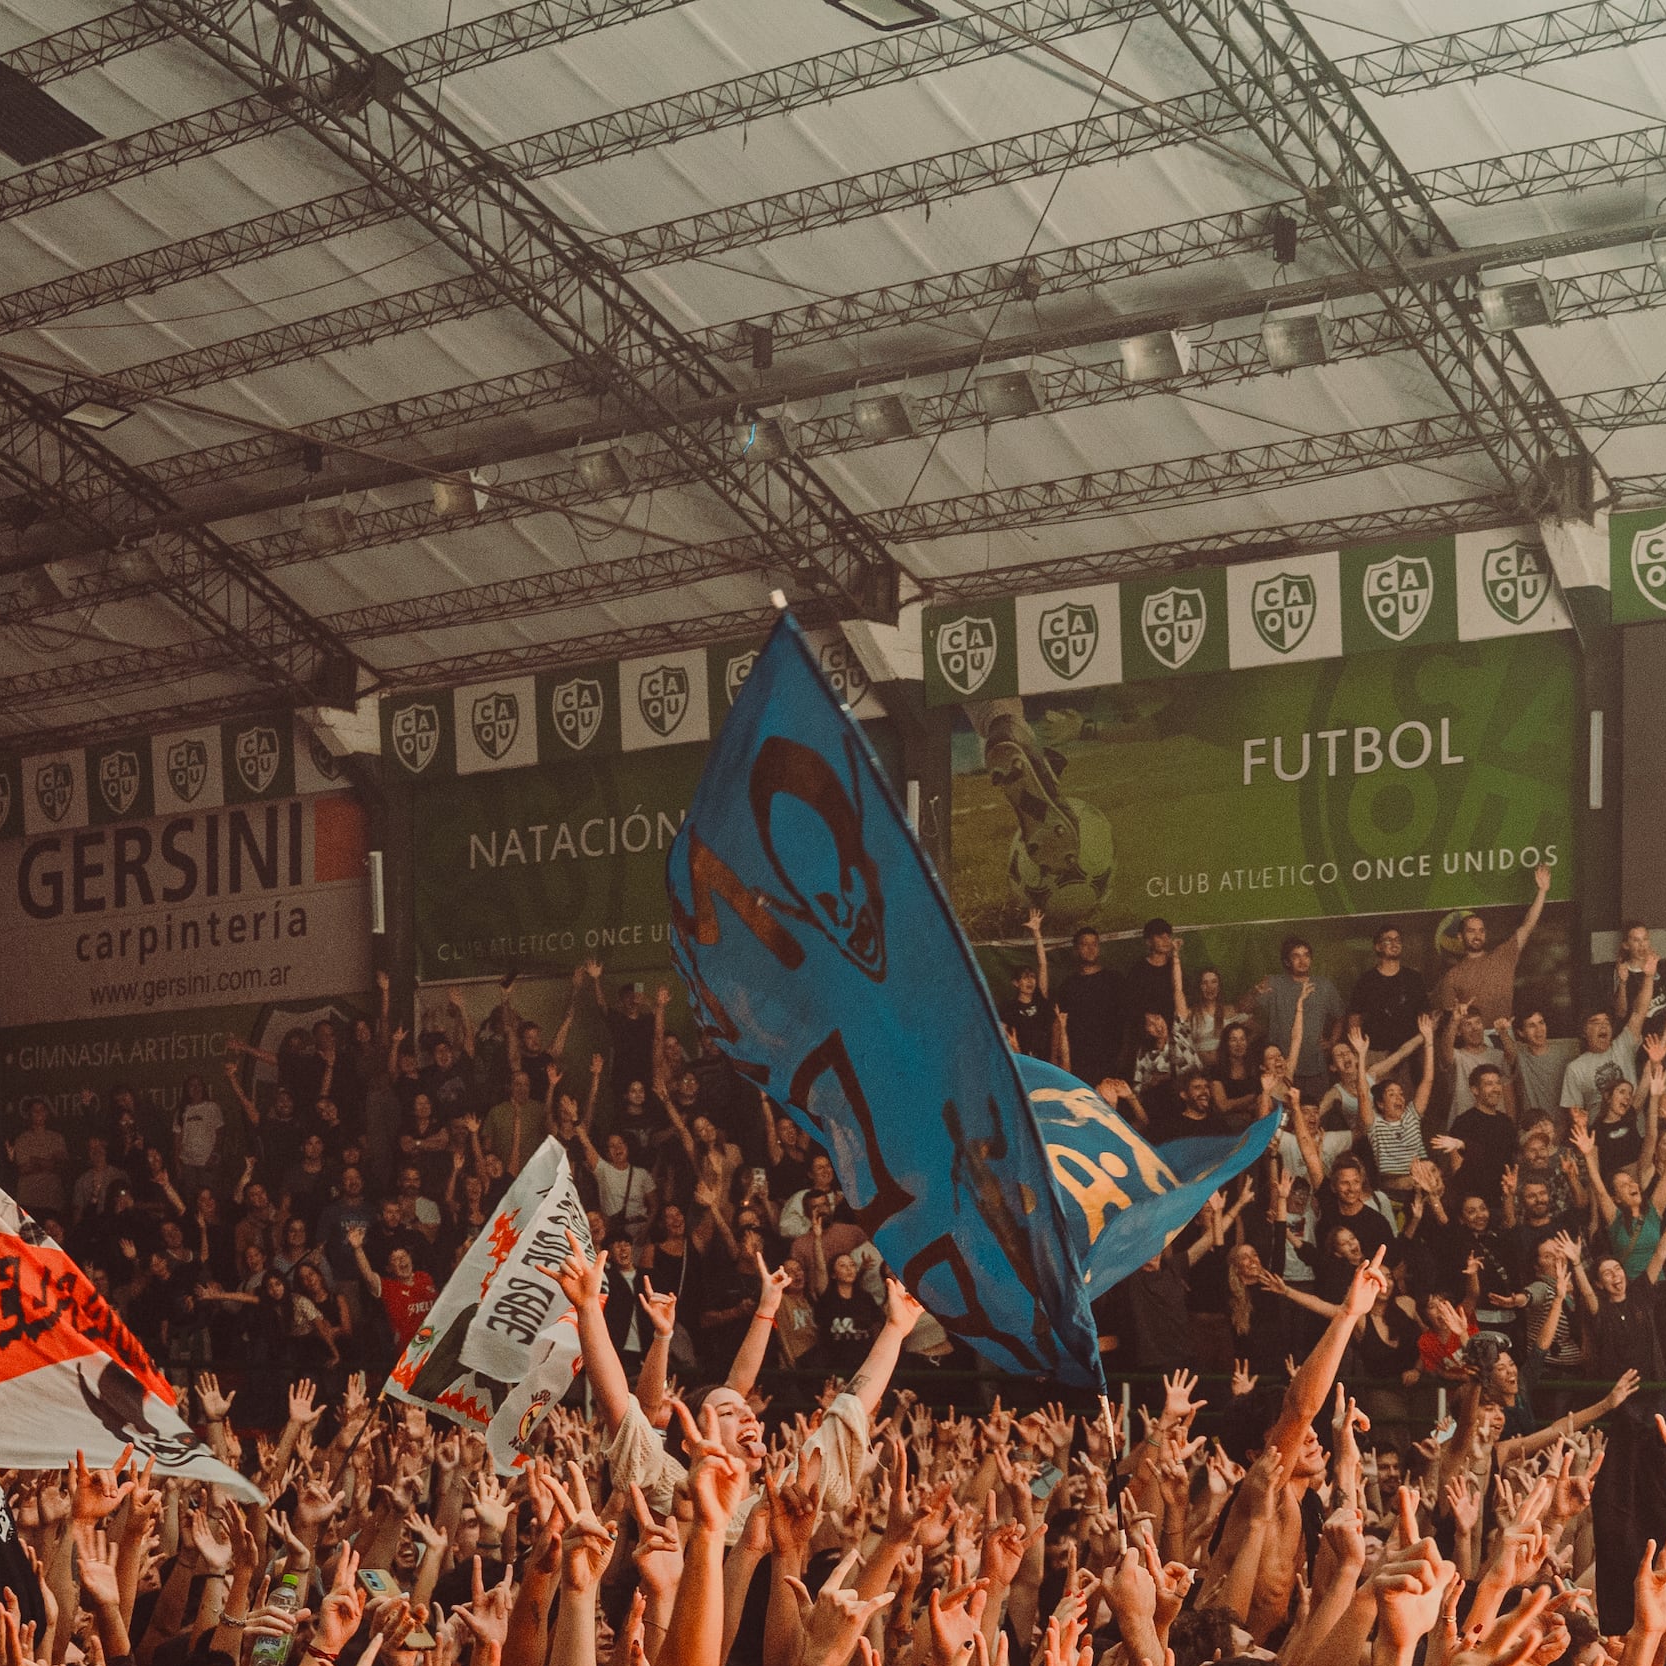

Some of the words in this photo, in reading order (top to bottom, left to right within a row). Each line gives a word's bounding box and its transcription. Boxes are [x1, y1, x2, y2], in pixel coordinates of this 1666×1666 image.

[1242, 716, 1464, 786] FUTBOL
[16, 800, 304, 920] GERSINI
[469, 804, 686, 870] NATACIÓN
[1147, 872, 1211, 900] CLUB
[1352, 852, 1432, 882] ONCE
[1442, 843, 1559, 875] UNIDOS
[76, 899, 309, 967] carpintería
[584, 924, 643, 949] ONCE
[89, 964, 291, 1007] www.gersini.com.ar
[18, 1041, 124, 1071] GIMNASIA
